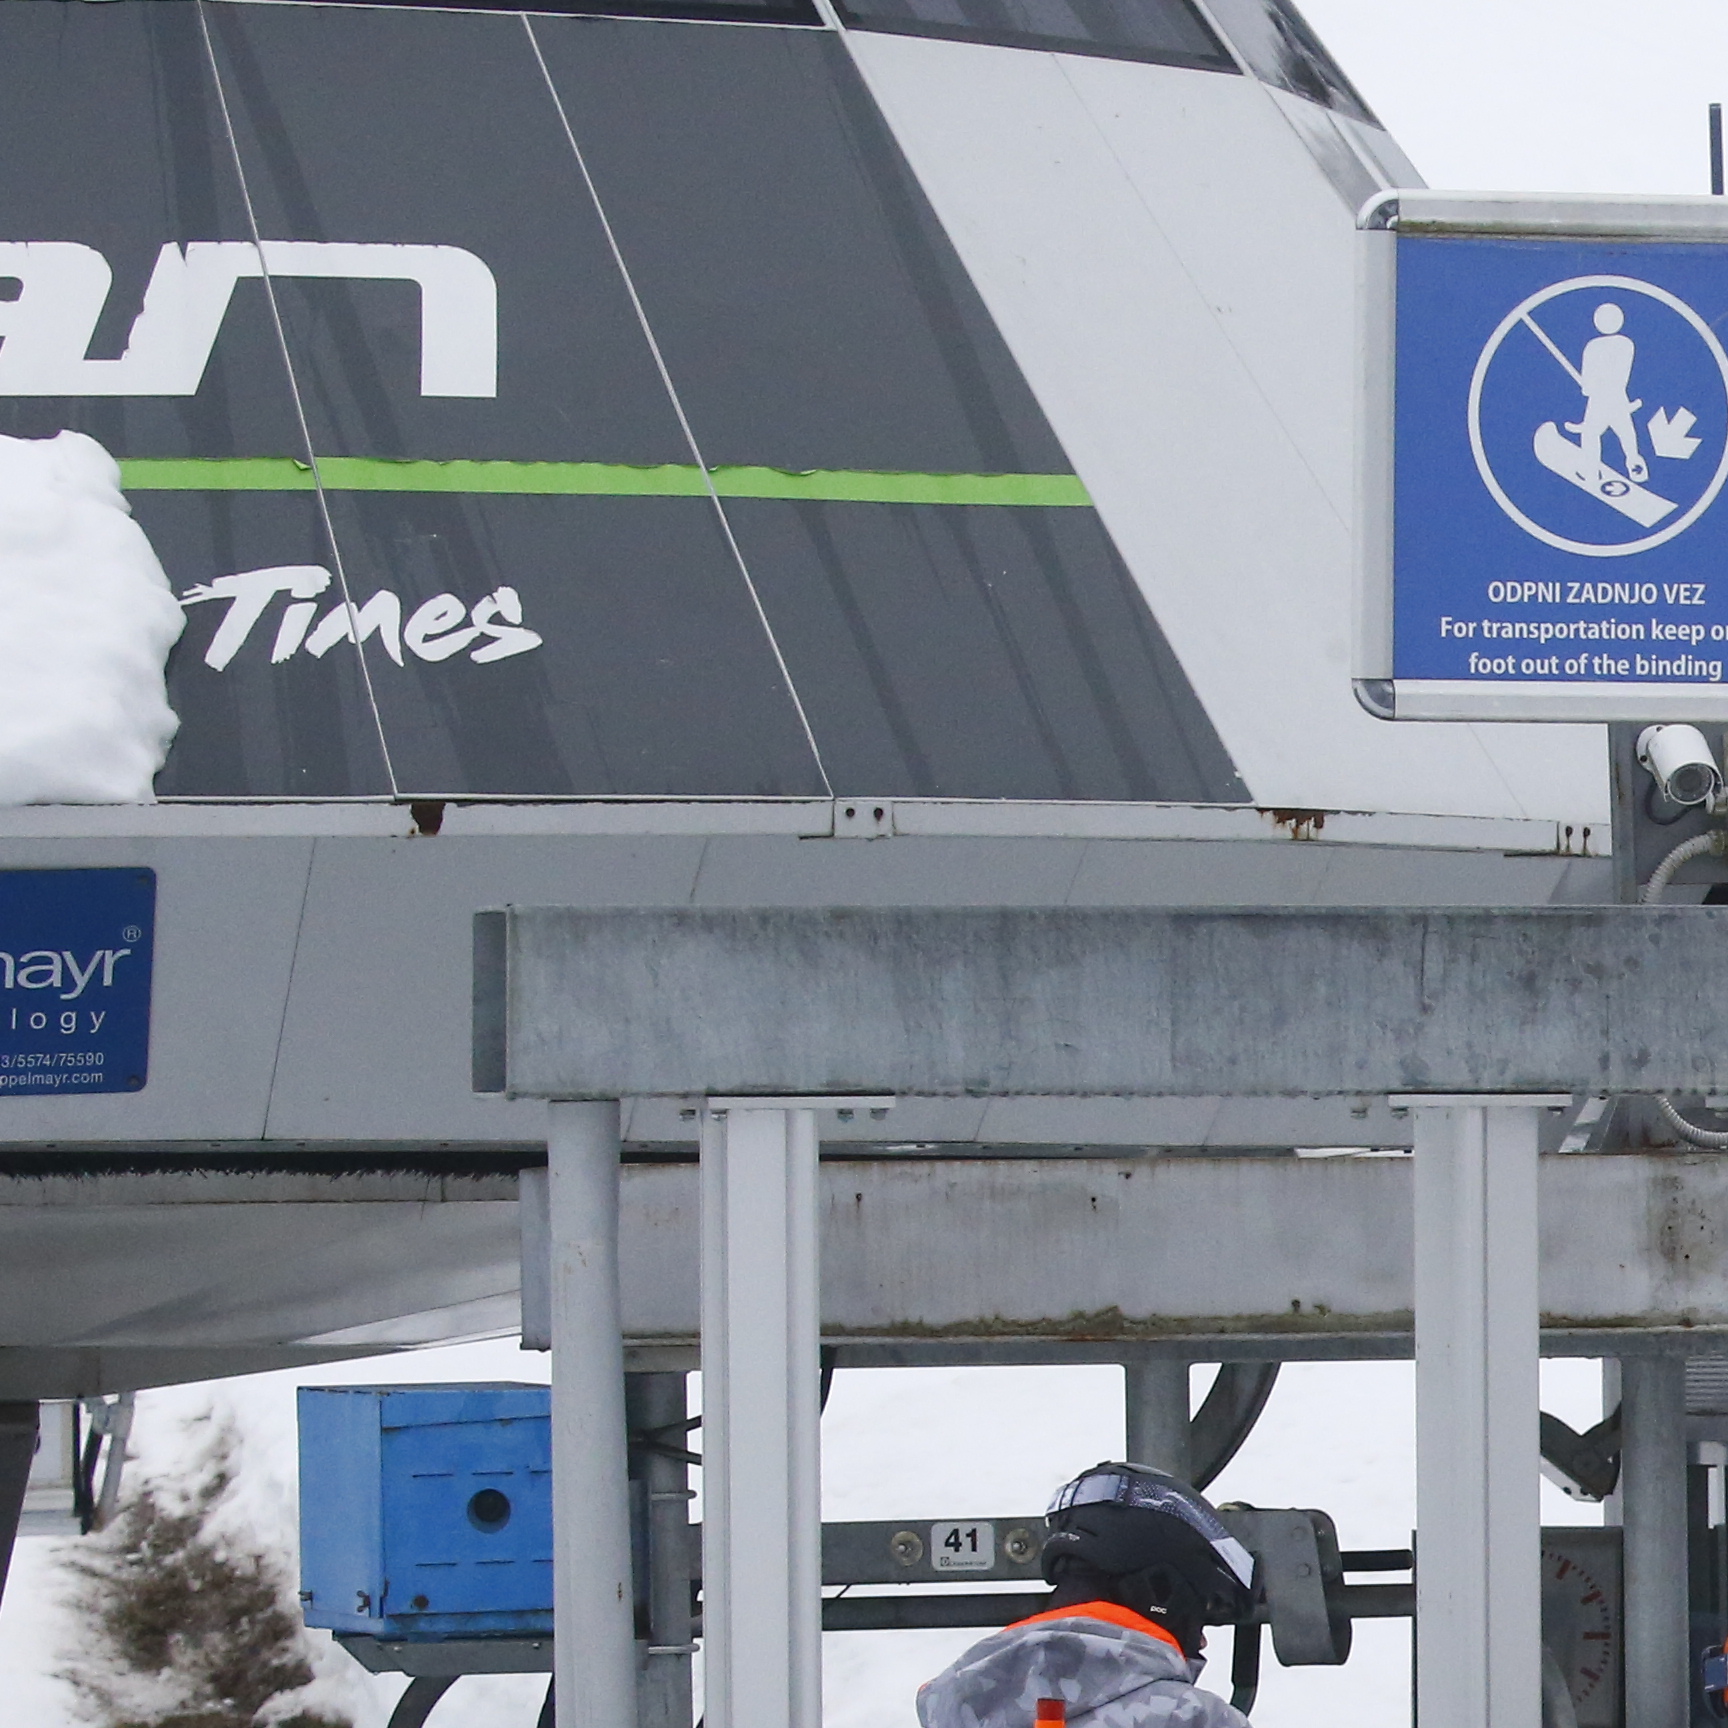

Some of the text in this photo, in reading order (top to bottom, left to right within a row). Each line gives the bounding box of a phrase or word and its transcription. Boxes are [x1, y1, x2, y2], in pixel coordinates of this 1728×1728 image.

[1488, 581, 1705, 604] ODPNI ZADNJO VEZ
[180, 564, 543, 672] Times
[1441, 617, 1477, 637] For
[1482, 618, 1644, 643] transportation
[1652, 618, 1705, 645] keep
[1469, 652, 1721, 680] foot out of the binding
[1, 1052, 104, 1068] 3/5574/75590
[945, 1528, 978, 1552] 41
